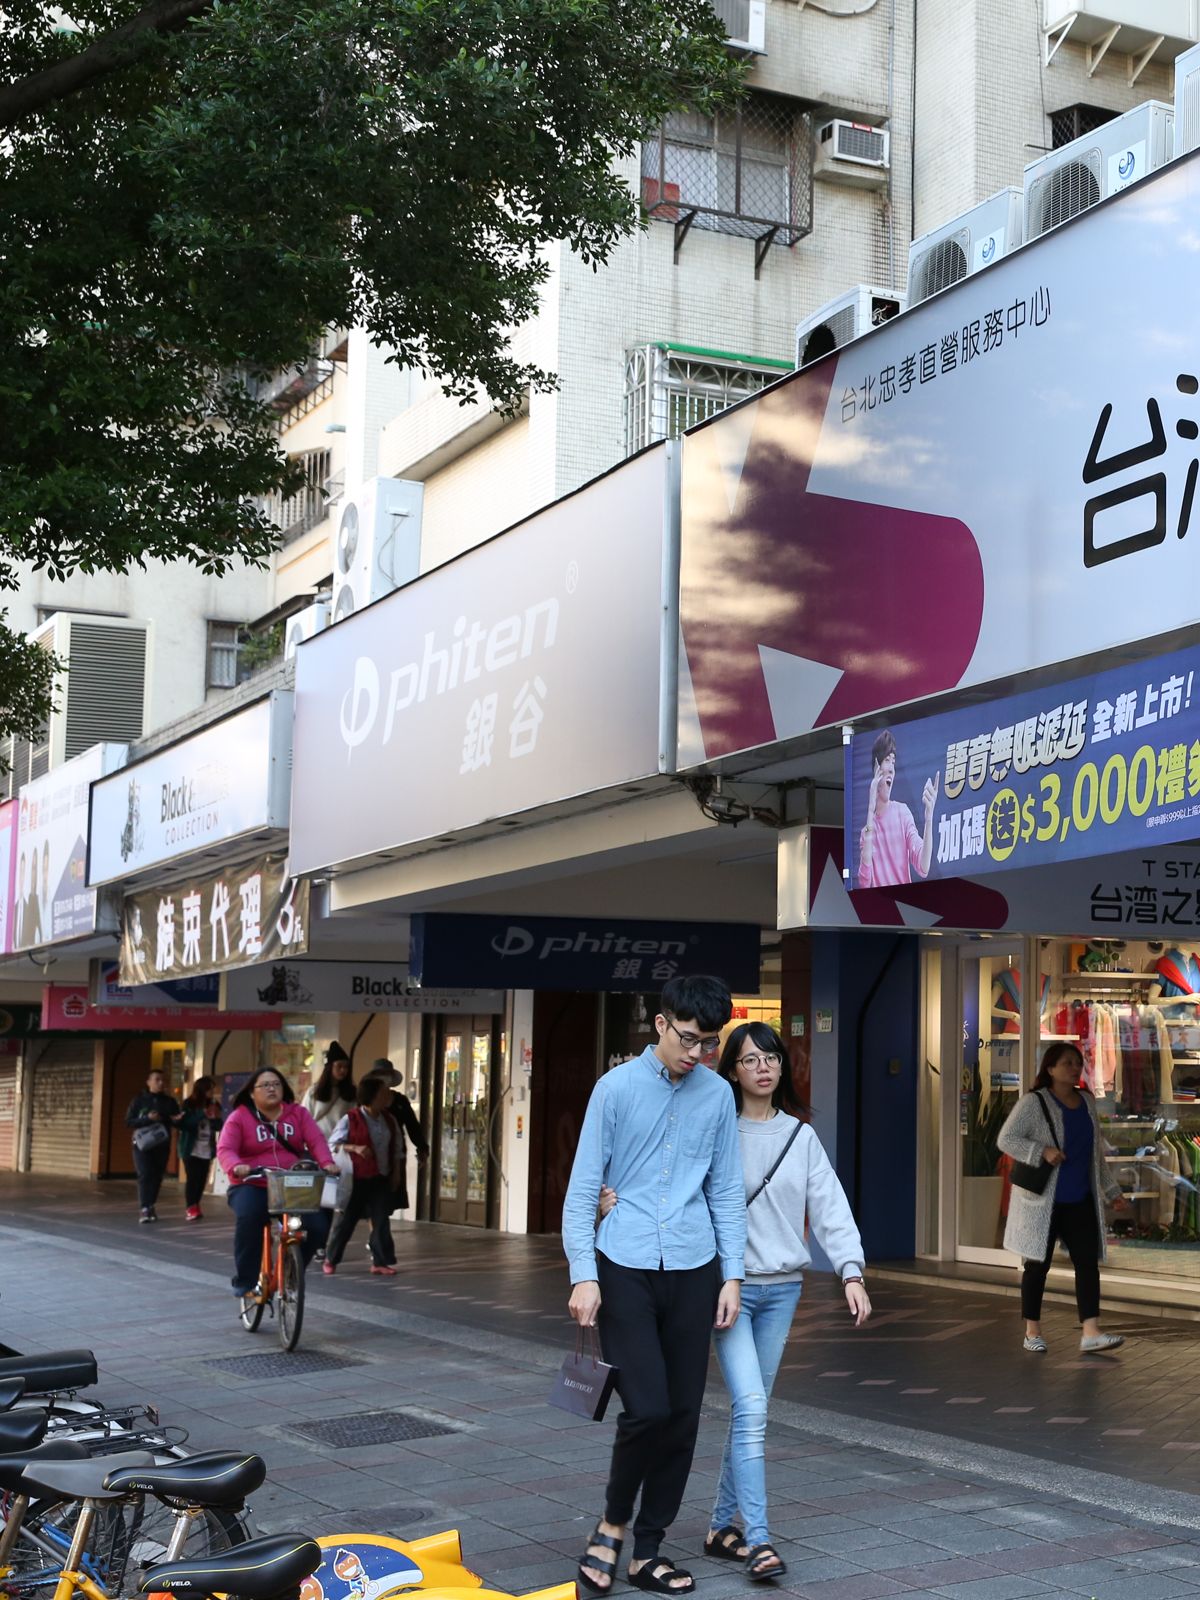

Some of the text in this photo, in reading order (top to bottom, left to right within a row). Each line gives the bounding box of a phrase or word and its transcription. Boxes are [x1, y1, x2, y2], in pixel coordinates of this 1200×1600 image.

[840, 284, 1052, 424] 台北忠孝直營服務中心
[382, 597, 560, 746] phiten
[459, 674, 549, 776] 銀谷
[160, 776, 187, 824] Black
[164, 810, 220, 847] COLLECTION
[1142, 859, 1157, 877] T
[155, 873, 263, 973] 結束代理
[538, 931, 688, 960] phiten
[352, 976, 403, 997] Black
[612, 958, 680, 981] 銀谷
[362, 998, 461, 1008] COLLECTION
